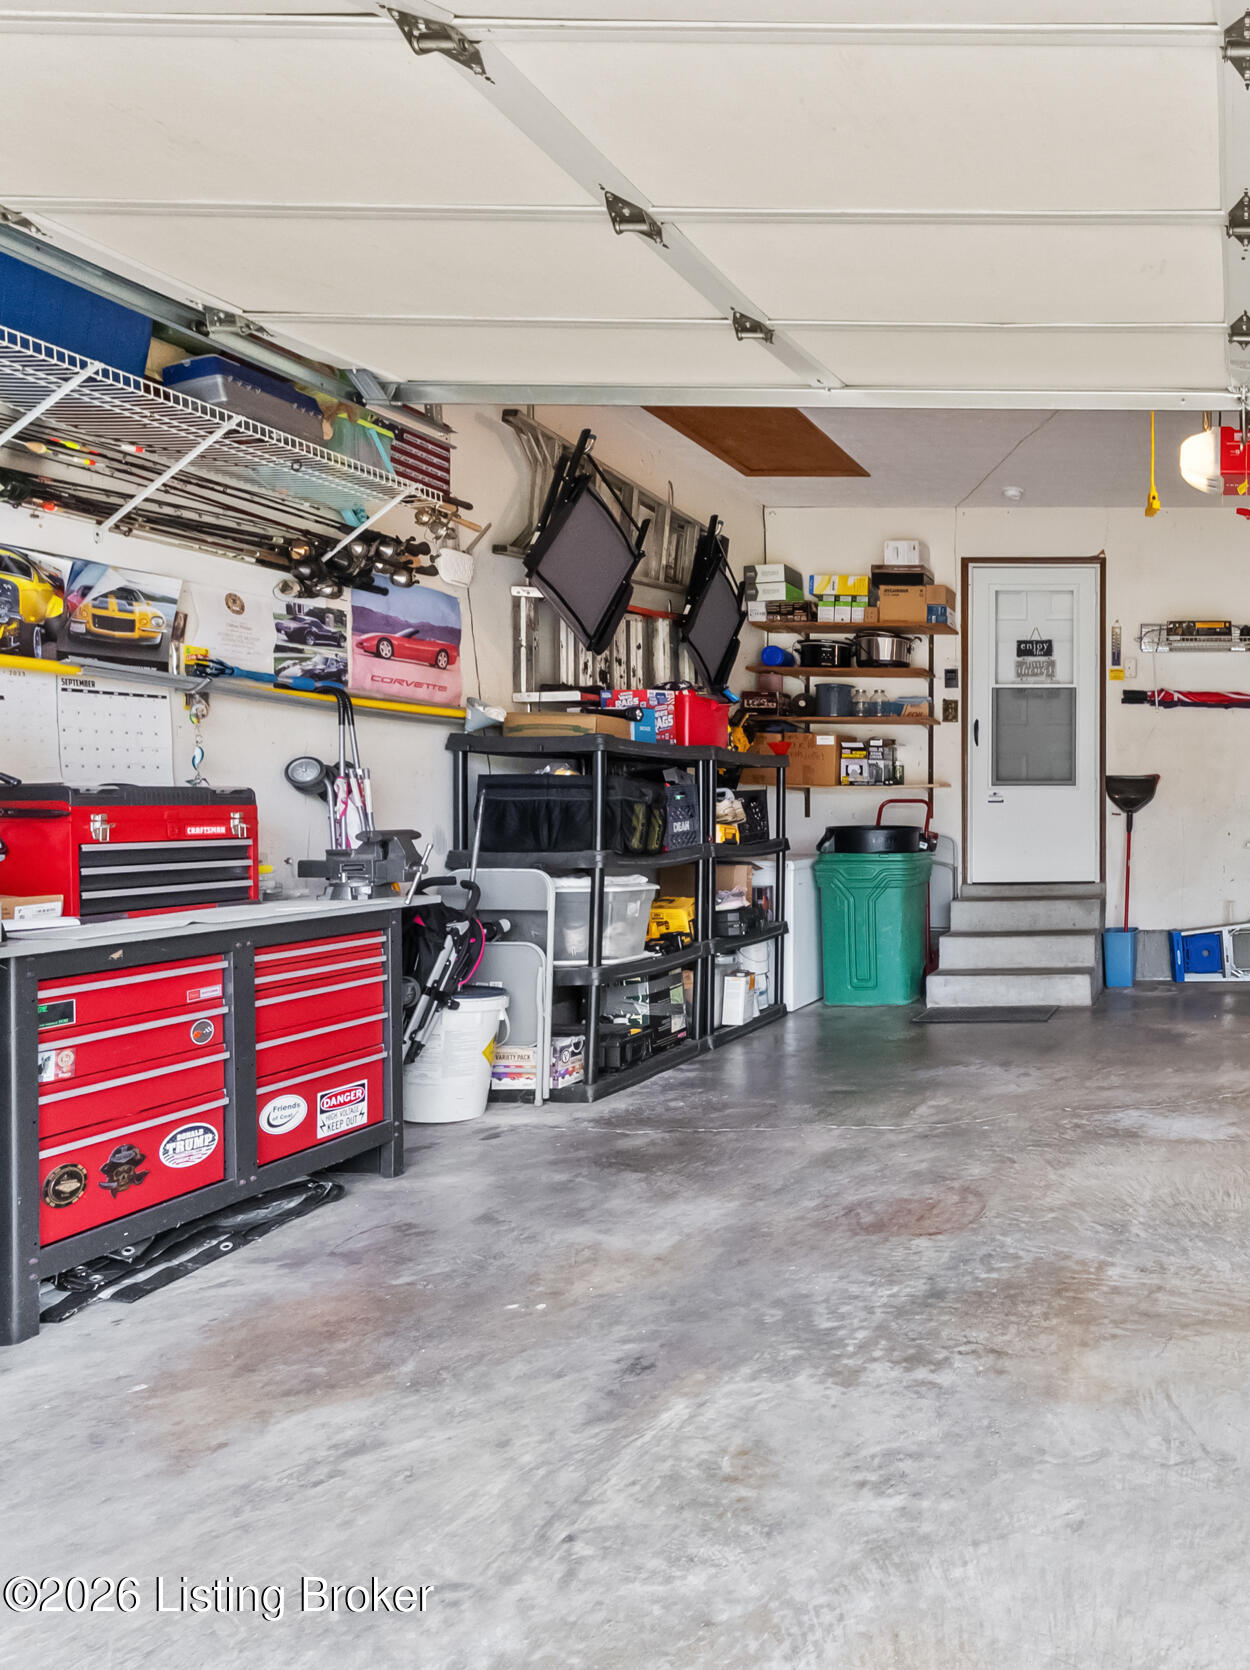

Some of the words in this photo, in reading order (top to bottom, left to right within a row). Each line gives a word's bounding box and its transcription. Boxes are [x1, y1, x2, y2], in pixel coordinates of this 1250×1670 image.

[61, 677, 96, 688] SEPTEMBER
[370, 674, 448, 692] CORVETTE
[186, 826, 226, 835] CRAFTSMAN
[323, 1088, 363, 1108] DANGER
[272, 1101, 301, 1113] Friends
[325, 1111, 338, 1120] HIGH
[340, 1106, 360, 1117] VOLTAGE
[327, 1119, 344, 1132] KEEP
[345, 1115, 358, 1127] OUT
[165, 1133, 214, 1152] TRUMP
